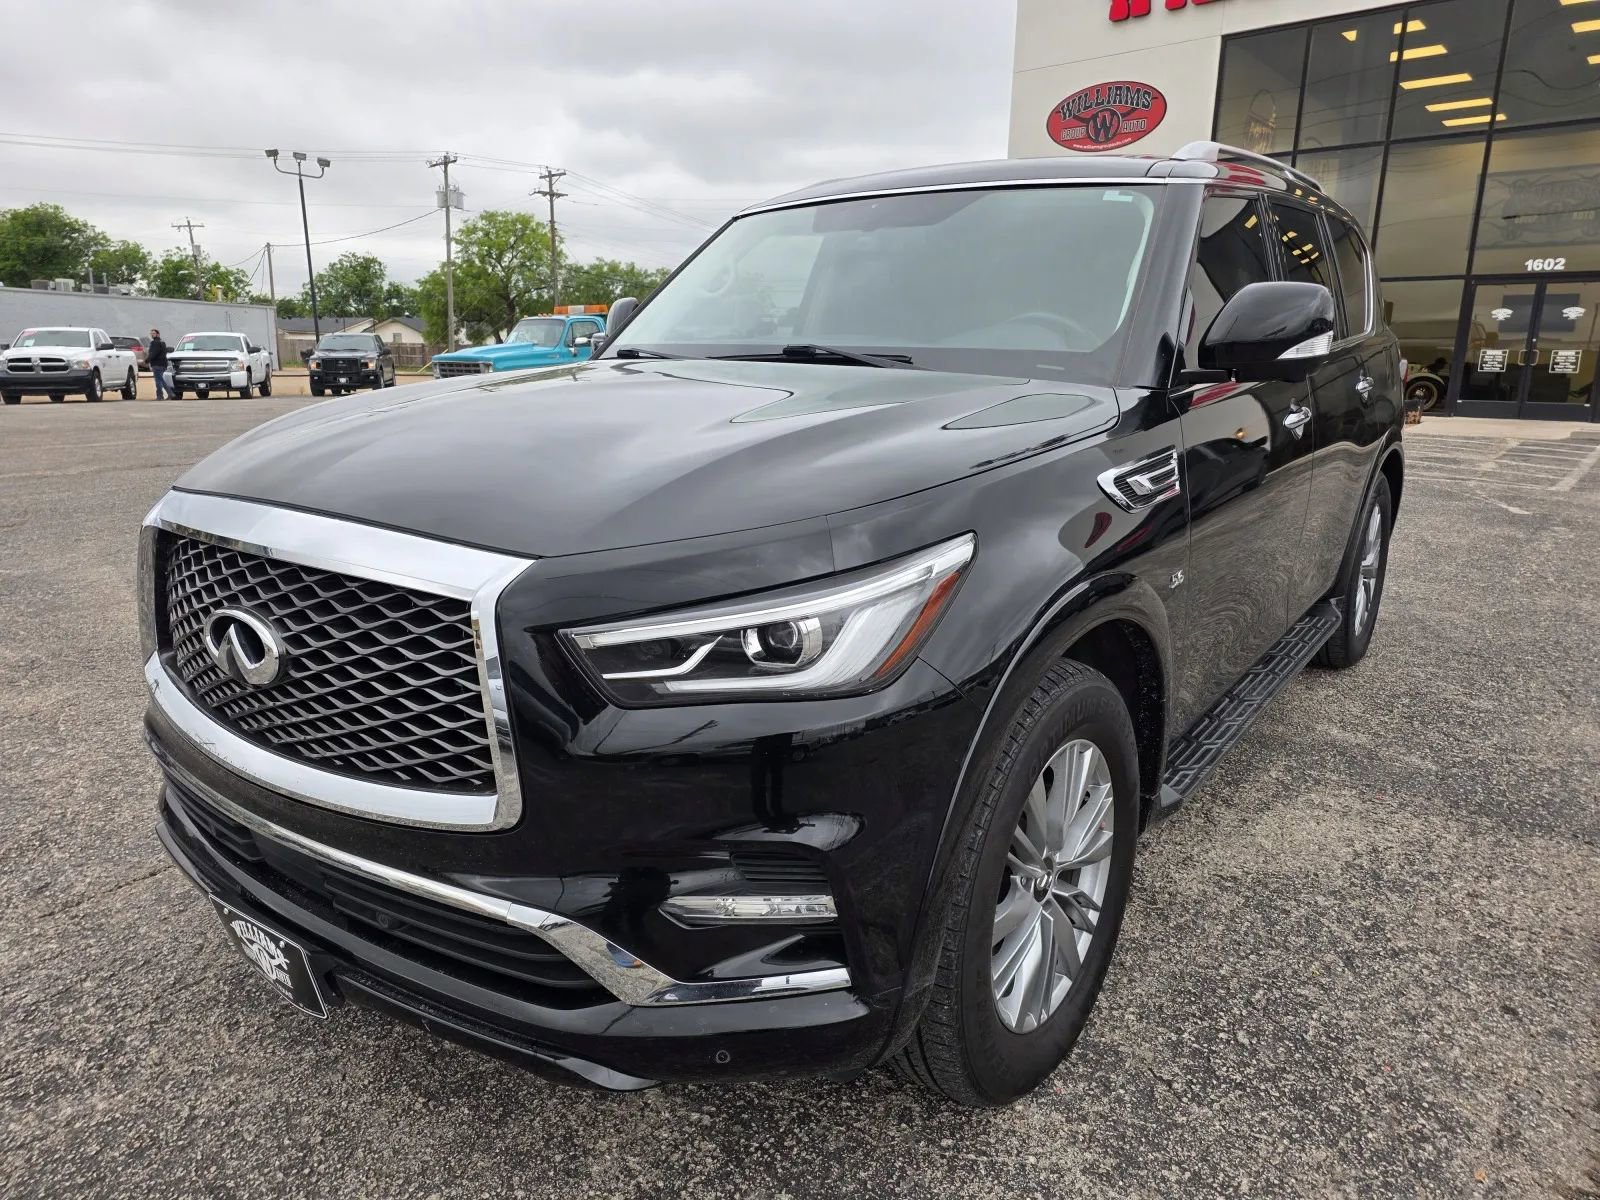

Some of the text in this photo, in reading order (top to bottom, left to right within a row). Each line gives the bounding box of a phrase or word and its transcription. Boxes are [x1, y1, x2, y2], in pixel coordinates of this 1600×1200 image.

[1060, 85, 1152, 121] WILLIAMS
[1061, 126, 1087, 140] GROUP
[1121, 119, 1147, 133] AUTO
[1524, 257, 1567, 272] 1602
[230, 920, 288, 970] WILLIAMS
